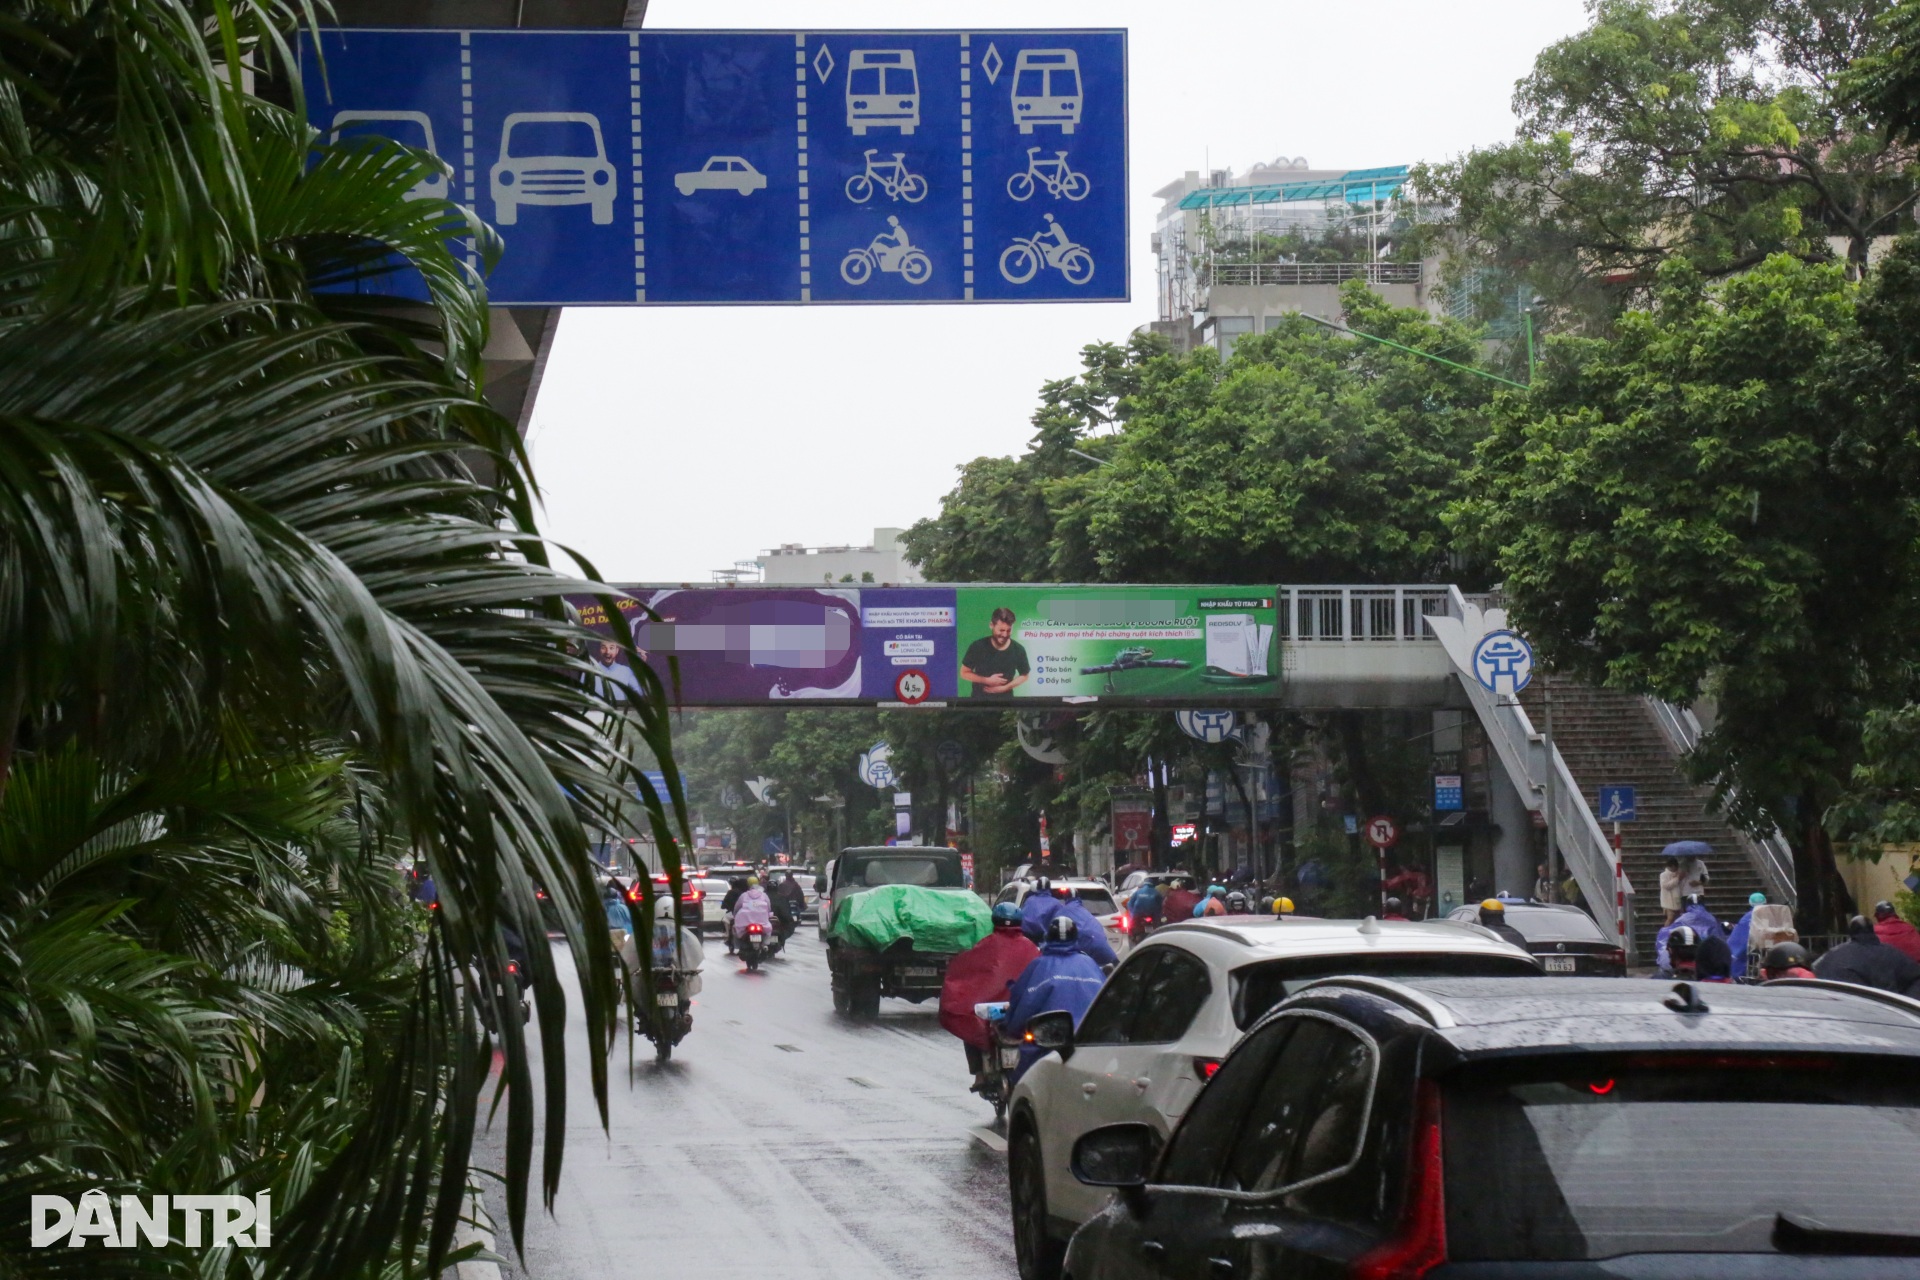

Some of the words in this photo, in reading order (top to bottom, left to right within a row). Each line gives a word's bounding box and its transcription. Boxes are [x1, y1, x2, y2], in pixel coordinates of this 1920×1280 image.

[1173, 617, 1198, 627] RUỘT
[1039, 631, 1053, 639] hợp
[1067, 631, 1080, 639] mọi
